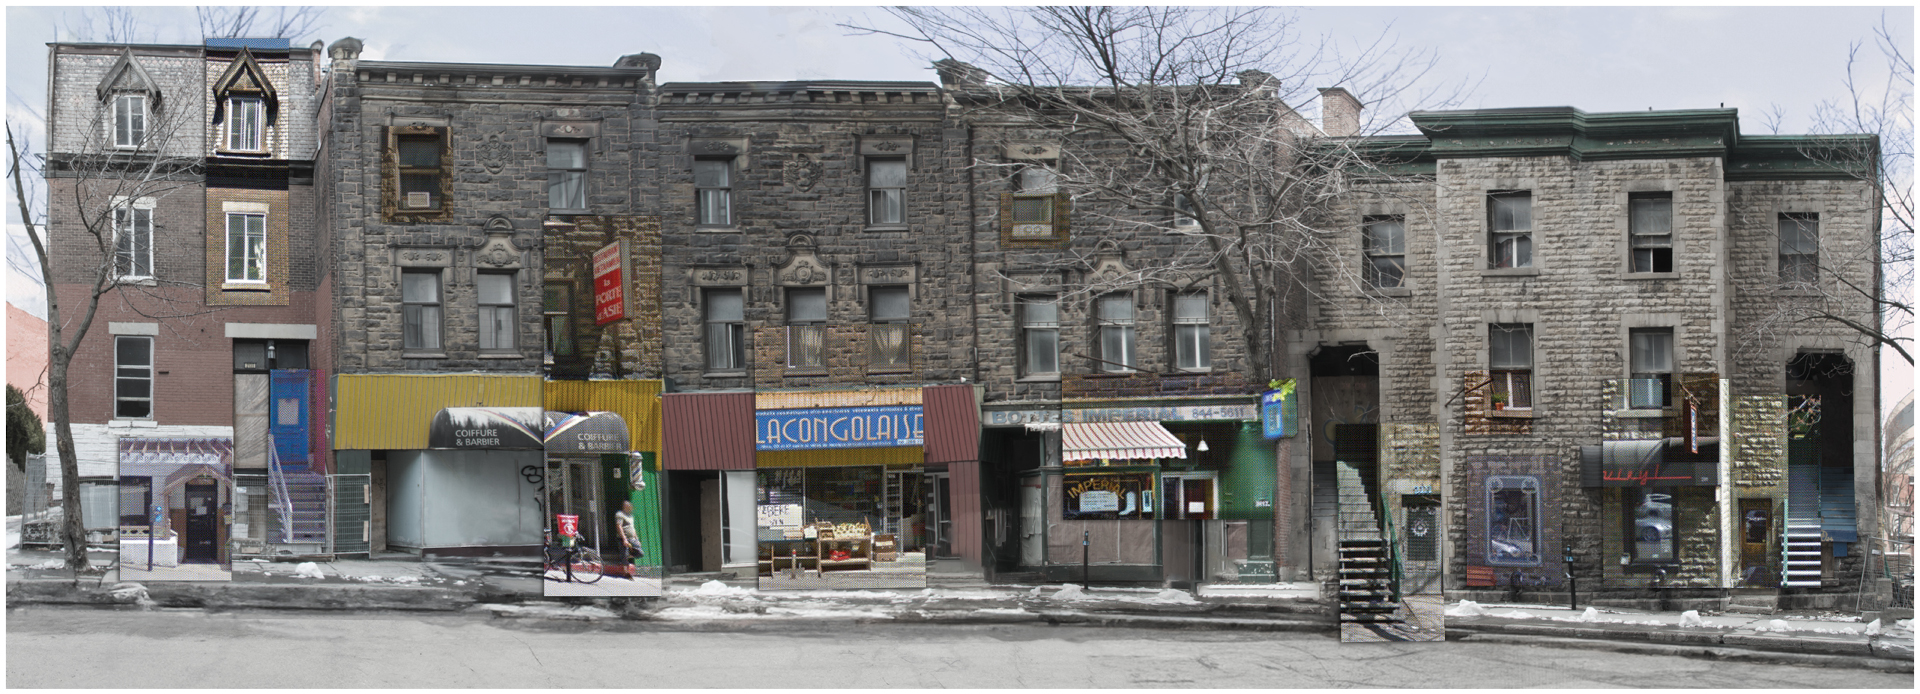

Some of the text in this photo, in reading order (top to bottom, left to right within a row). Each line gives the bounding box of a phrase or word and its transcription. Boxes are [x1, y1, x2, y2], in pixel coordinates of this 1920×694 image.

[596, 286, 621, 305] PORTE
[992, 409, 1074, 424] BOTTES
[1081, 407, 1184, 422] IMPERIAL
[455, 429, 498, 438] COIFFURE
[577, 433, 619, 441] COIFFURE
[456, 438, 500, 447] & BARBIER
[578, 442, 622, 450] & BARBIER
[1067, 479, 1126, 500] IMPERIAL
